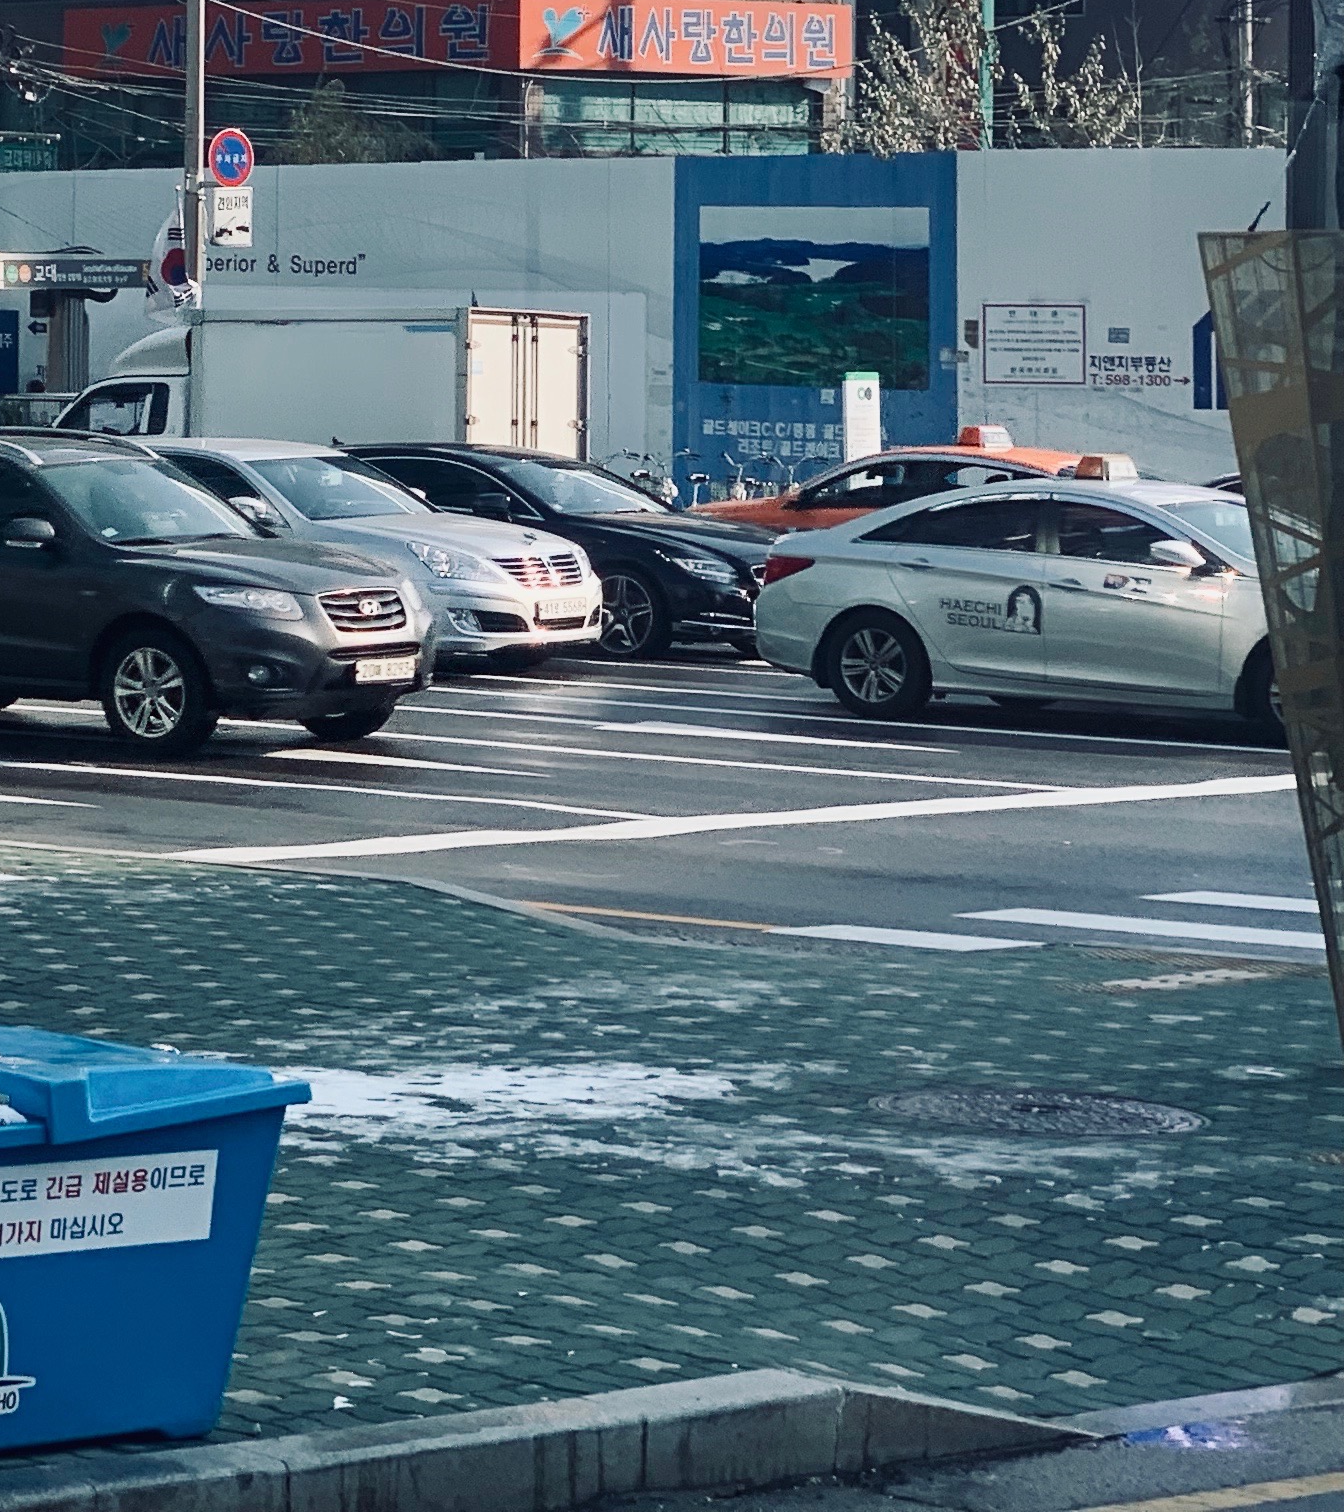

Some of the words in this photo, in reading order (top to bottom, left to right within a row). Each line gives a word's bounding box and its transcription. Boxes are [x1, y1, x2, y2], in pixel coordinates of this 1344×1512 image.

[146, 2, 491, 69] 새사랑한의원
[597, 4, 837, 69] 새사랑한의원
[267, 253, 280, 274] &
[940, 597, 1003, 616] HAECHI
[947, 611, 1005, 630] SEOUL
[46, 1174, 83, 1201] 긴급
[92, 1163, 206, 1195] 제설용이므로
[50, 1212, 125, 1241] 마십시오
